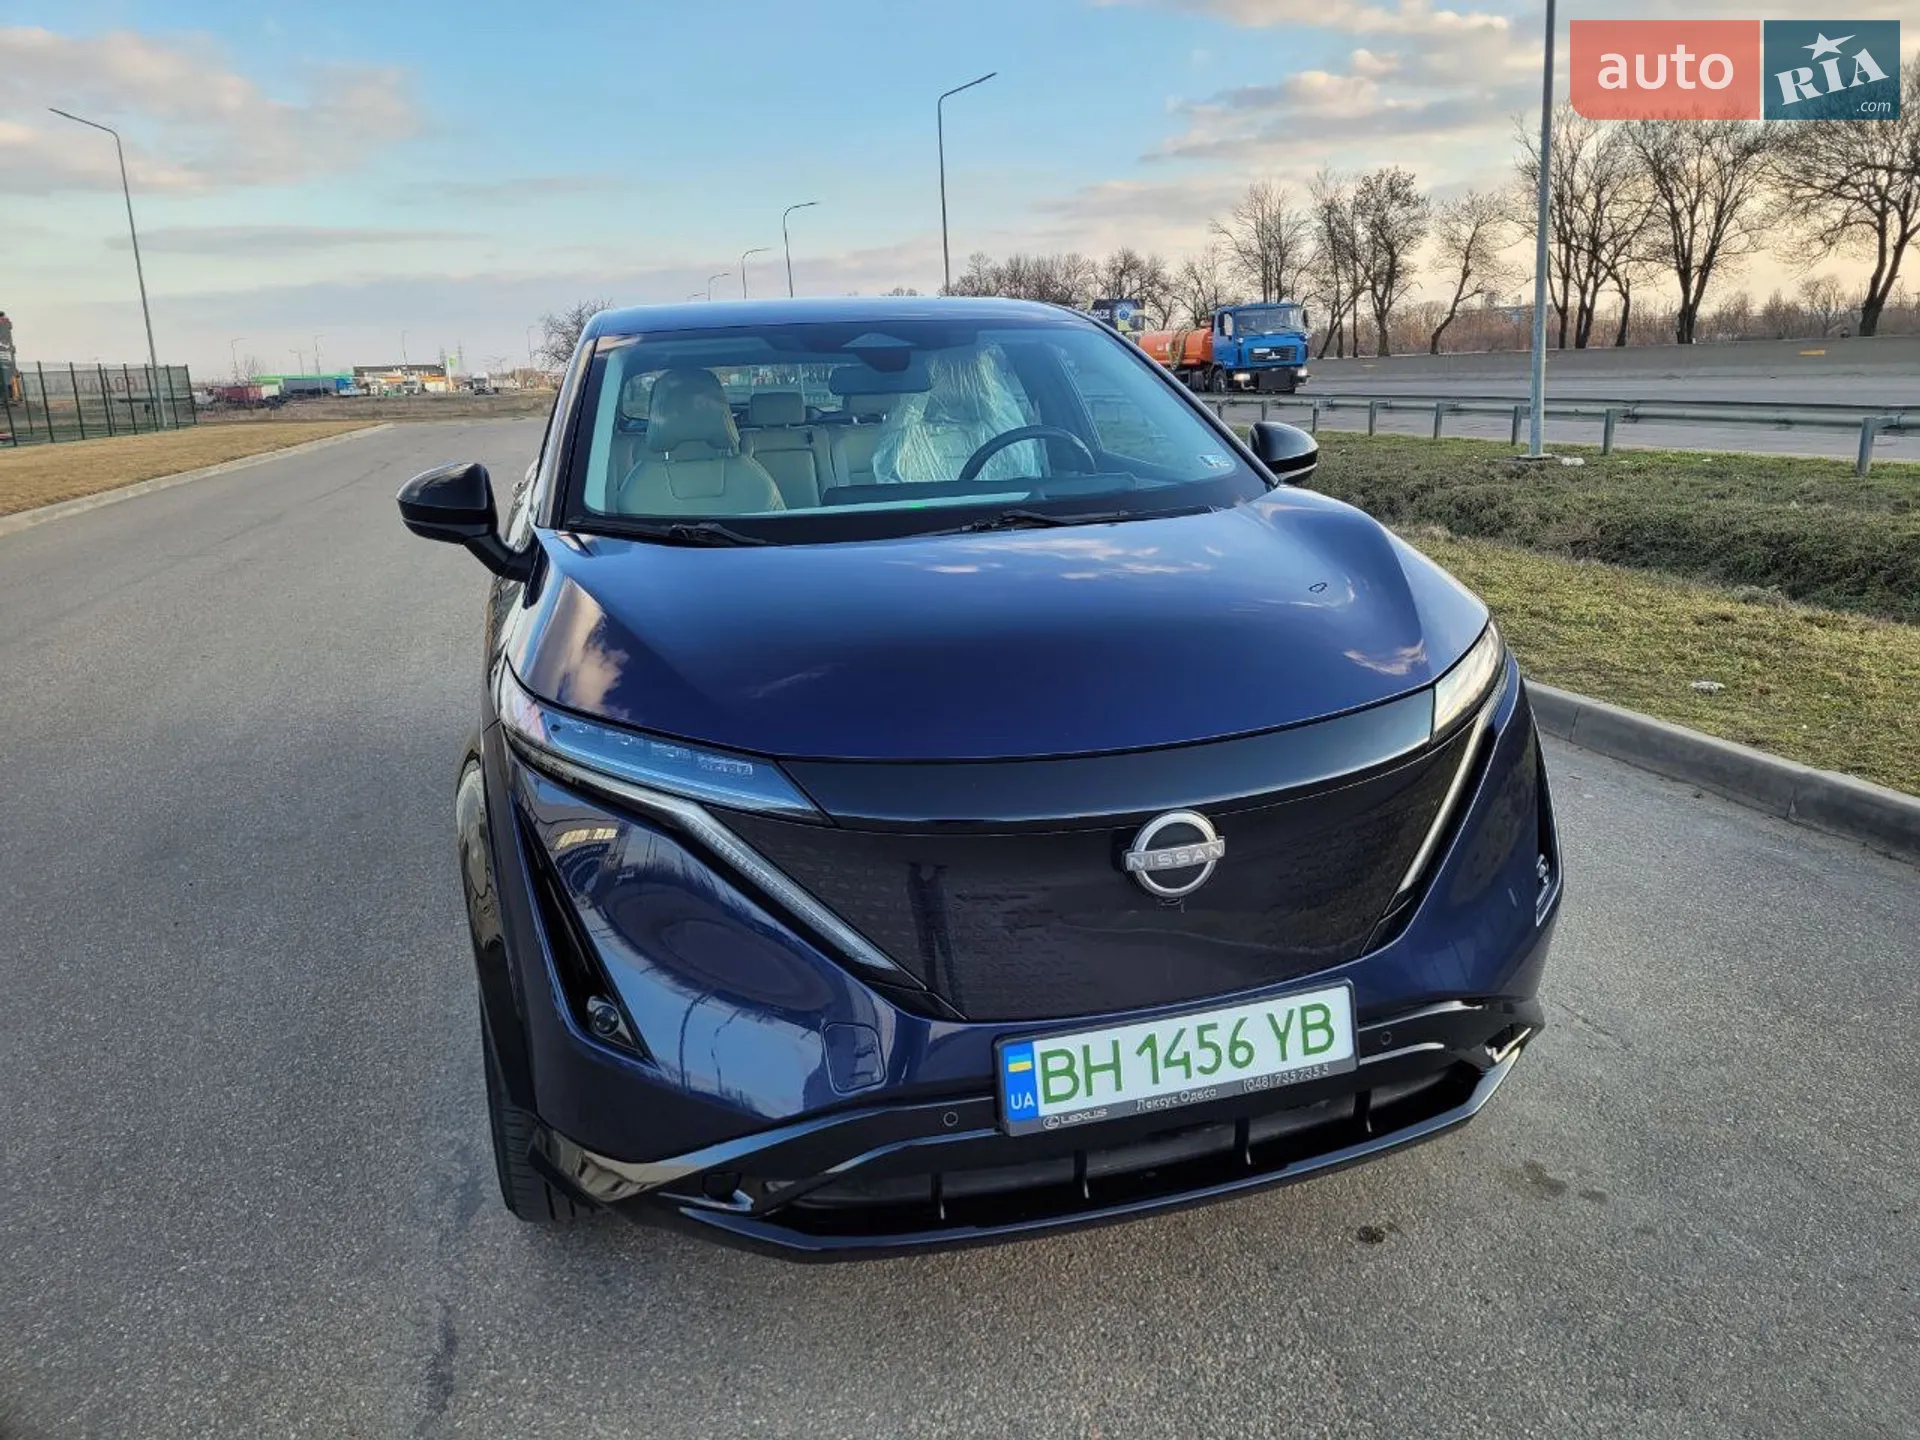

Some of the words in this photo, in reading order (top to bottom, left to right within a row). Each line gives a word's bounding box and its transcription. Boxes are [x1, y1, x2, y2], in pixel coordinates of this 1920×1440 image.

[1129, 844, 1222, 870] NISSAN
[1040, 1039, 1123, 1105] BH
[1135, 1016, 1255, 1085] 1456
[1266, 1002, 1335, 1062] YB
[1011, 1091, 1036, 1110] UA
